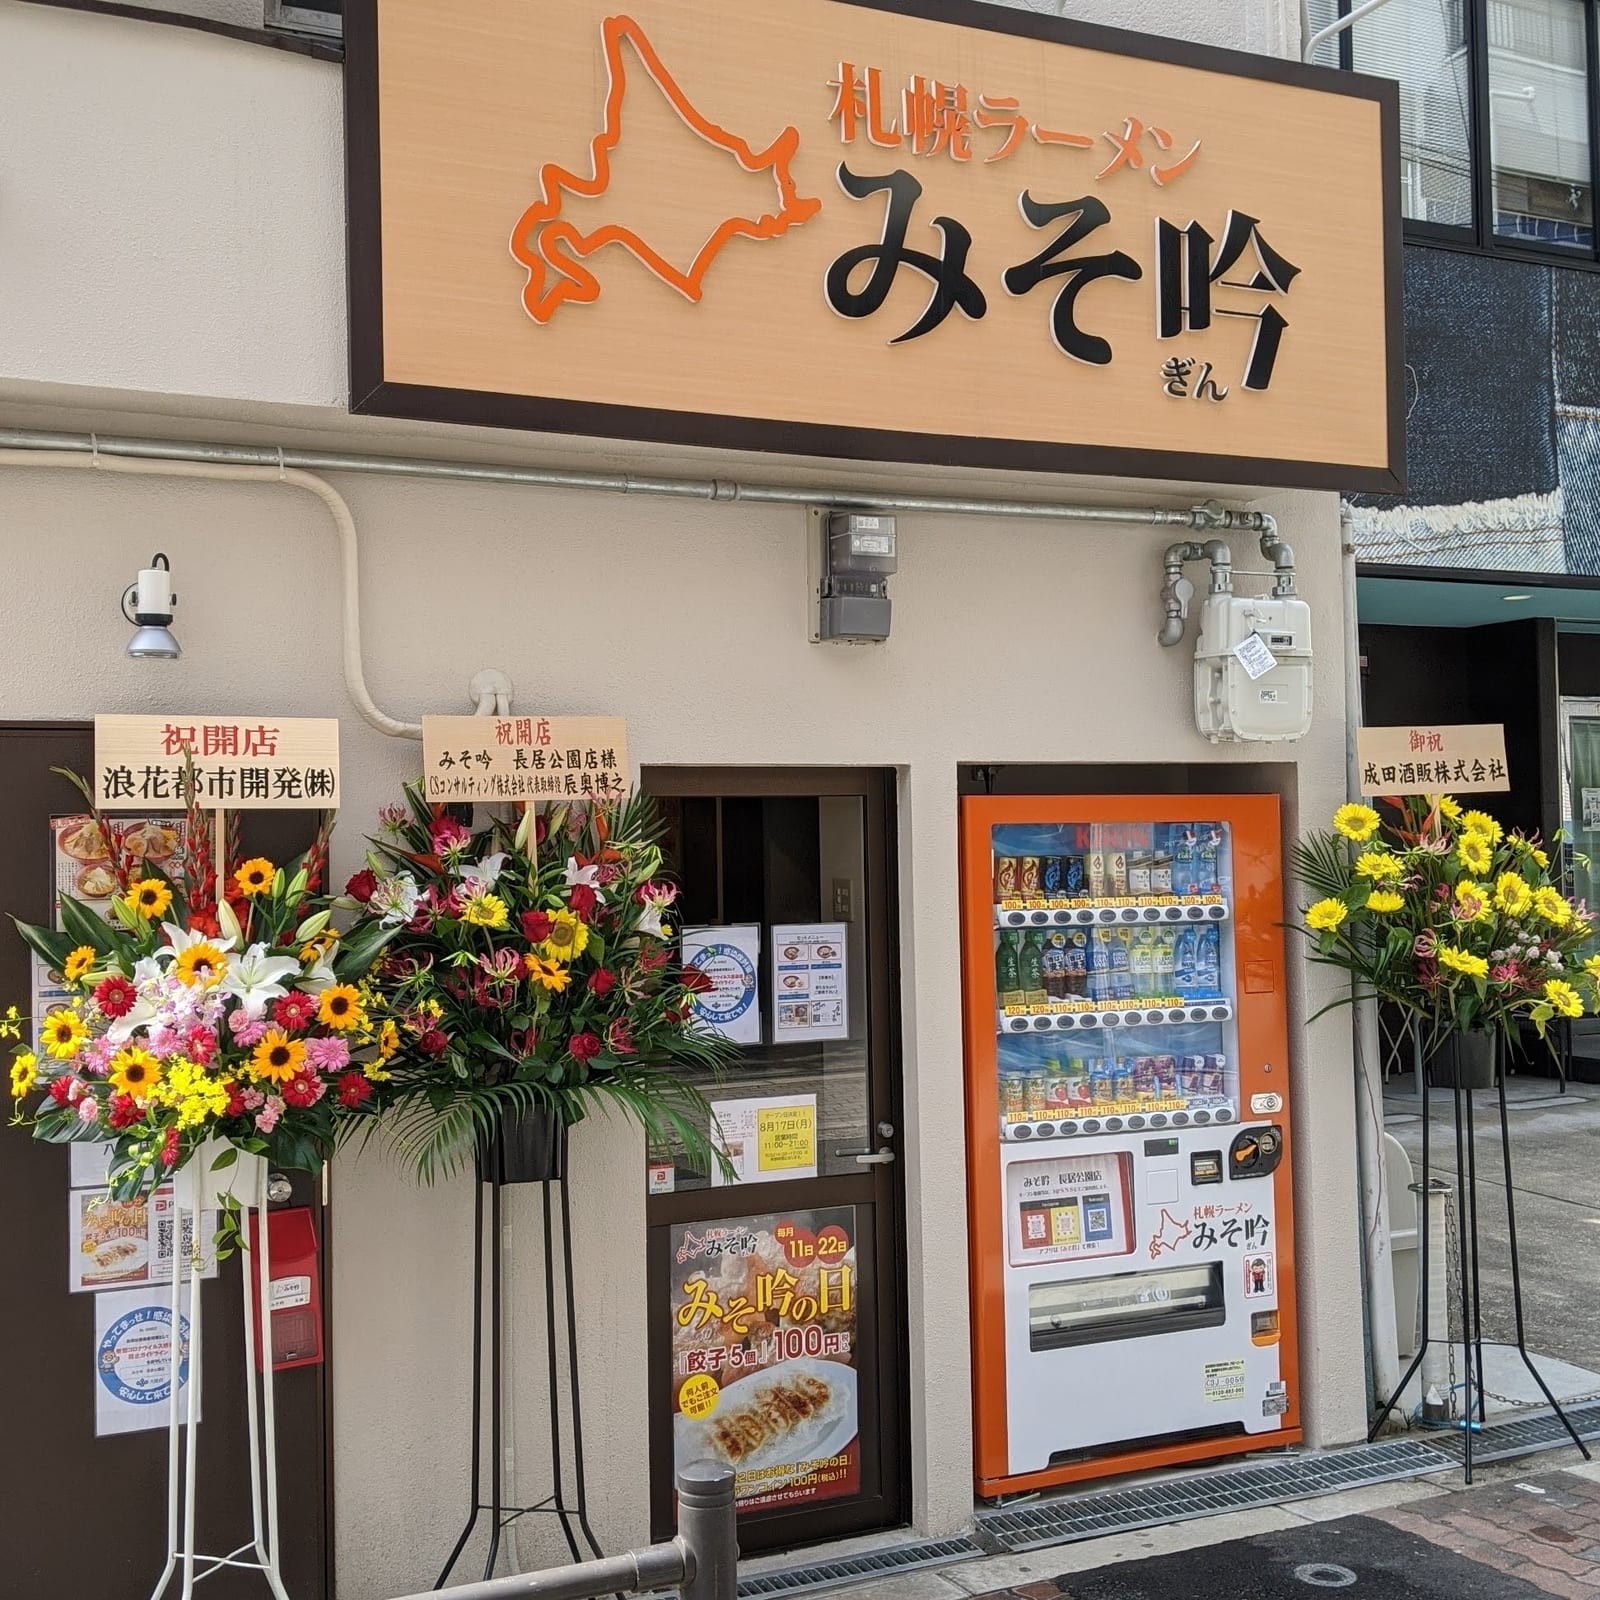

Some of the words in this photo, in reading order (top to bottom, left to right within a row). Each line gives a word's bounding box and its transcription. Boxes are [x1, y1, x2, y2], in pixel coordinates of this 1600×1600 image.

[826, 60, 1202, 186] 札幌ラーメン
[823, 160, 1302, 390] みそ吟
[1160, 356, 1229, 402] ぎん
[160, 723, 280, 757] 祝開店
[495, 717, 551, 746] 祝開店
[1408, 729, 1443, 753] 御祝
[438, 750, 493, 770] みそ吟
[512, 747, 618, 770] 長居公園店様
[1363, 757, 1506, 786] 成田酒販株式会社
[1007, 956, 1017, 979] 生茶
[1030, 957, 1040, 979] 生茶
[774, 1133, 798, 1142] 営業時間
[1193, 1202, 1253, 1220] 札幌ラーメン
[705, 1233, 758, 1257] みそ吟
[777, 1227, 794, 1238] 毎月
[1192, 1214, 1270, 1252] みそ吟
[677, 1264, 852, 1337] みそ吟の日
